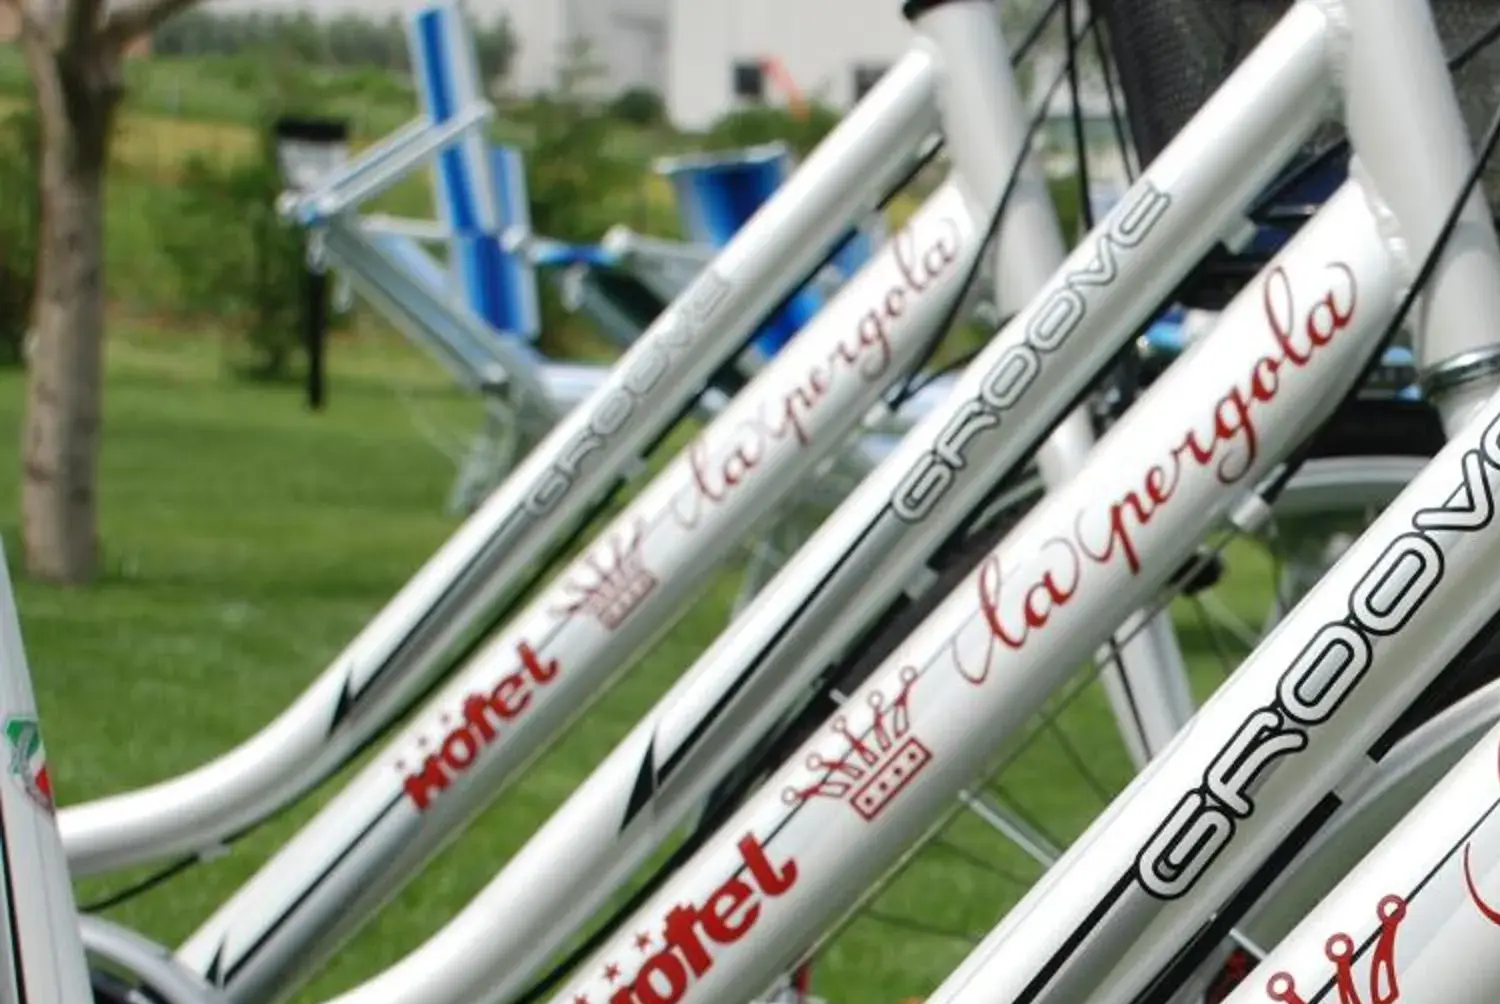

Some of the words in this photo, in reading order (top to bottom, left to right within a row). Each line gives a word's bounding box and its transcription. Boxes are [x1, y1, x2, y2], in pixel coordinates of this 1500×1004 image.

[400, 640, 560, 812] Hotel
[670, 395, 785, 529] la
[757, 214, 961, 444] pergola
[524, 267, 732, 517] GROOVE
[895, 187, 1170, 524] GROOVE
[953, 540, 1083, 684] la
[1075, 262, 1358, 576] pergola
